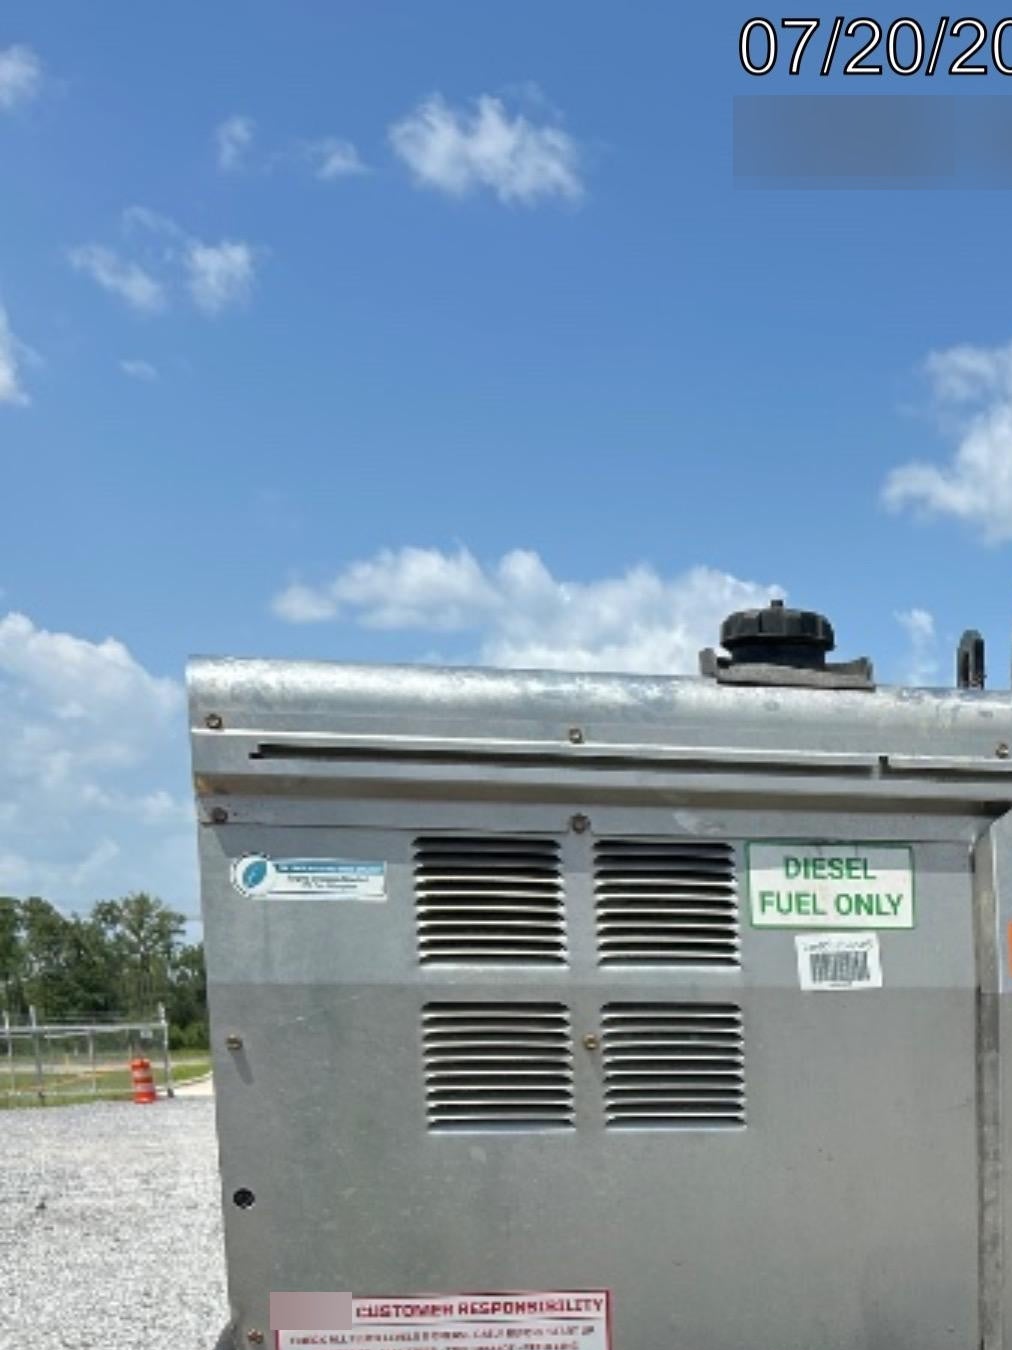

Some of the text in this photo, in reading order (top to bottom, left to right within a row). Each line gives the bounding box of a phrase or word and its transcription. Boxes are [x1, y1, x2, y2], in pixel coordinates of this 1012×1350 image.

[784, 857, 876, 880] DIESEL
[758, 890, 904, 916] FUEL ONLY
[356, 1298, 603, 1318] CUSTOMER RESPONSIBILITY
